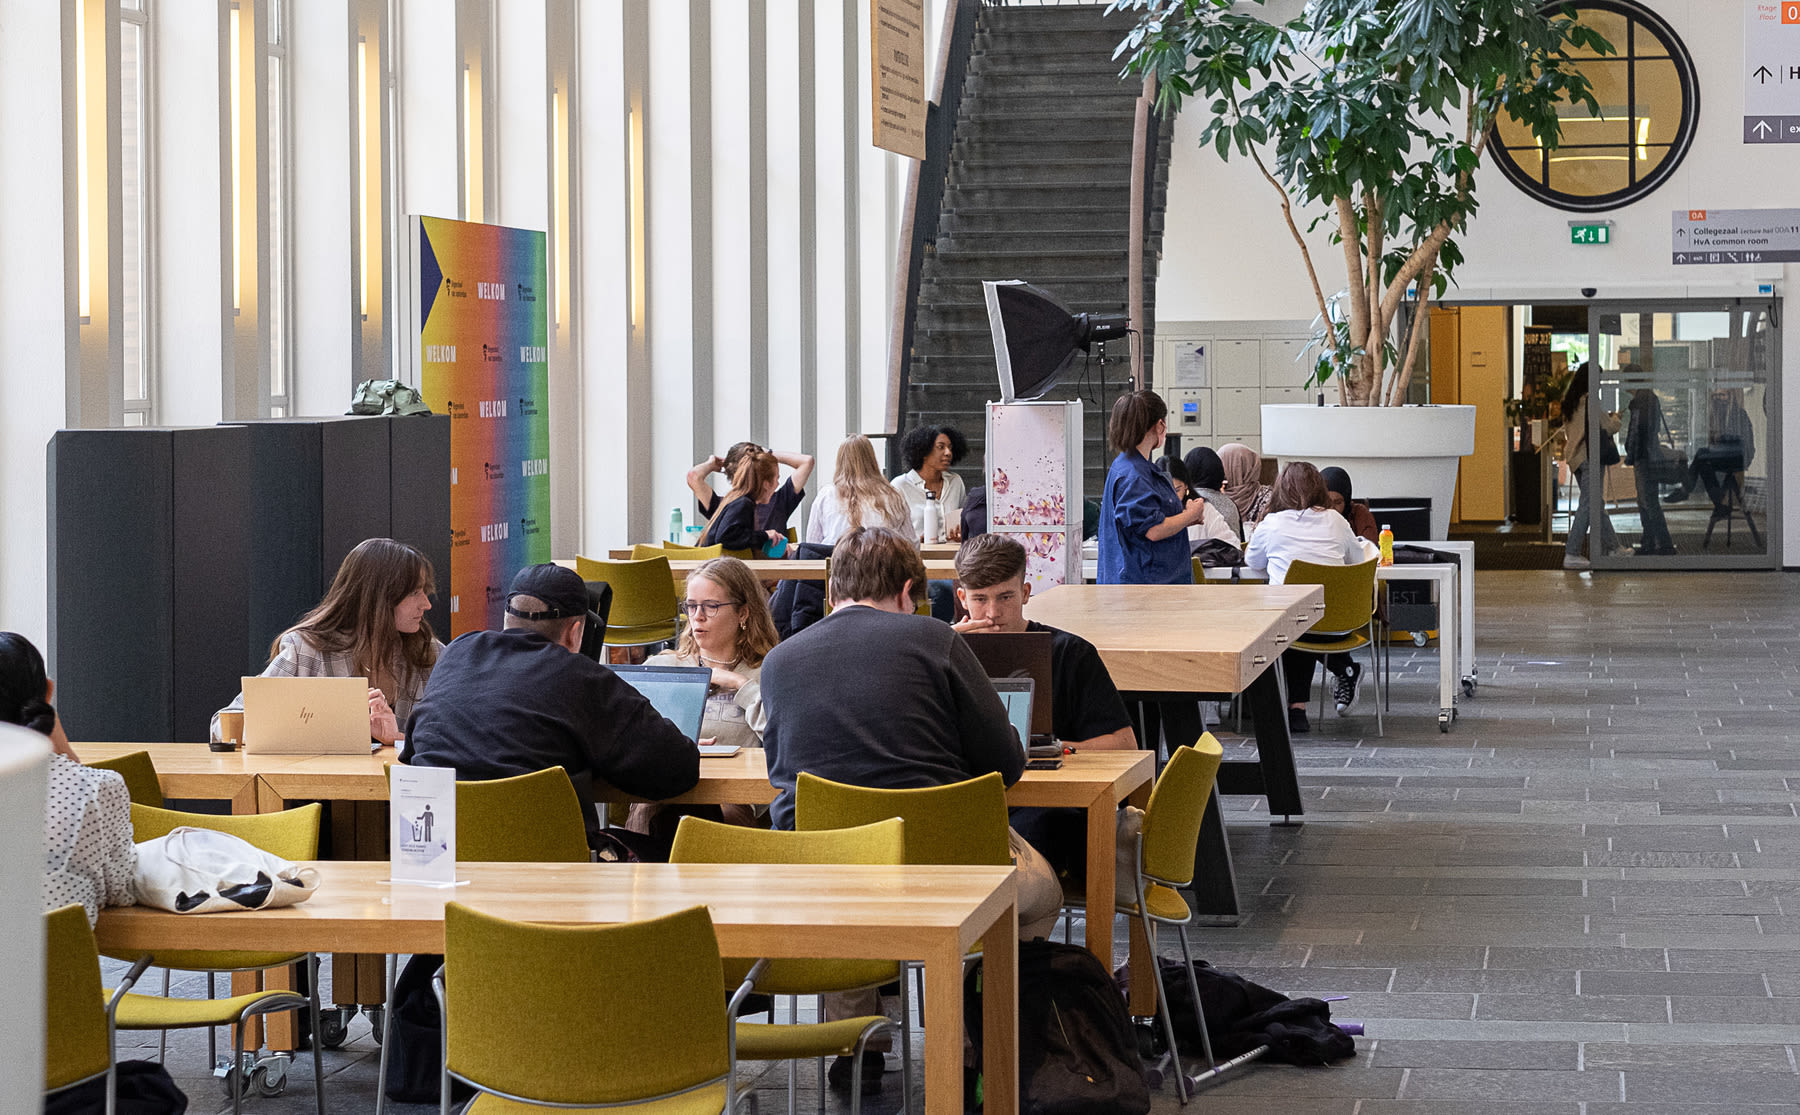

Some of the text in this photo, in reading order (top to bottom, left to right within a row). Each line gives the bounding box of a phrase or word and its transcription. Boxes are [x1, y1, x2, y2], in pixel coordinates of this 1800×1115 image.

[1788, 6, 1800, 20] 0
[1692, 212, 1703, 220] 0A
[1694, 227, 1738, 236] Collegezaal
[1711, 238, 1746, 246] common
[477, 282, 505, 300] WELKOM
[425, 345, 457, 363] WELKOM
[520, 346, 547, 363] WELKOM
[479, 400, 507, 418] WELKOM
[521, 458, 548, 477] WELKOM
[480, 522, 509, 543] WELKOM
[1392, 591, 1417, 605] EST
[300, 706, 314, 724] hp
